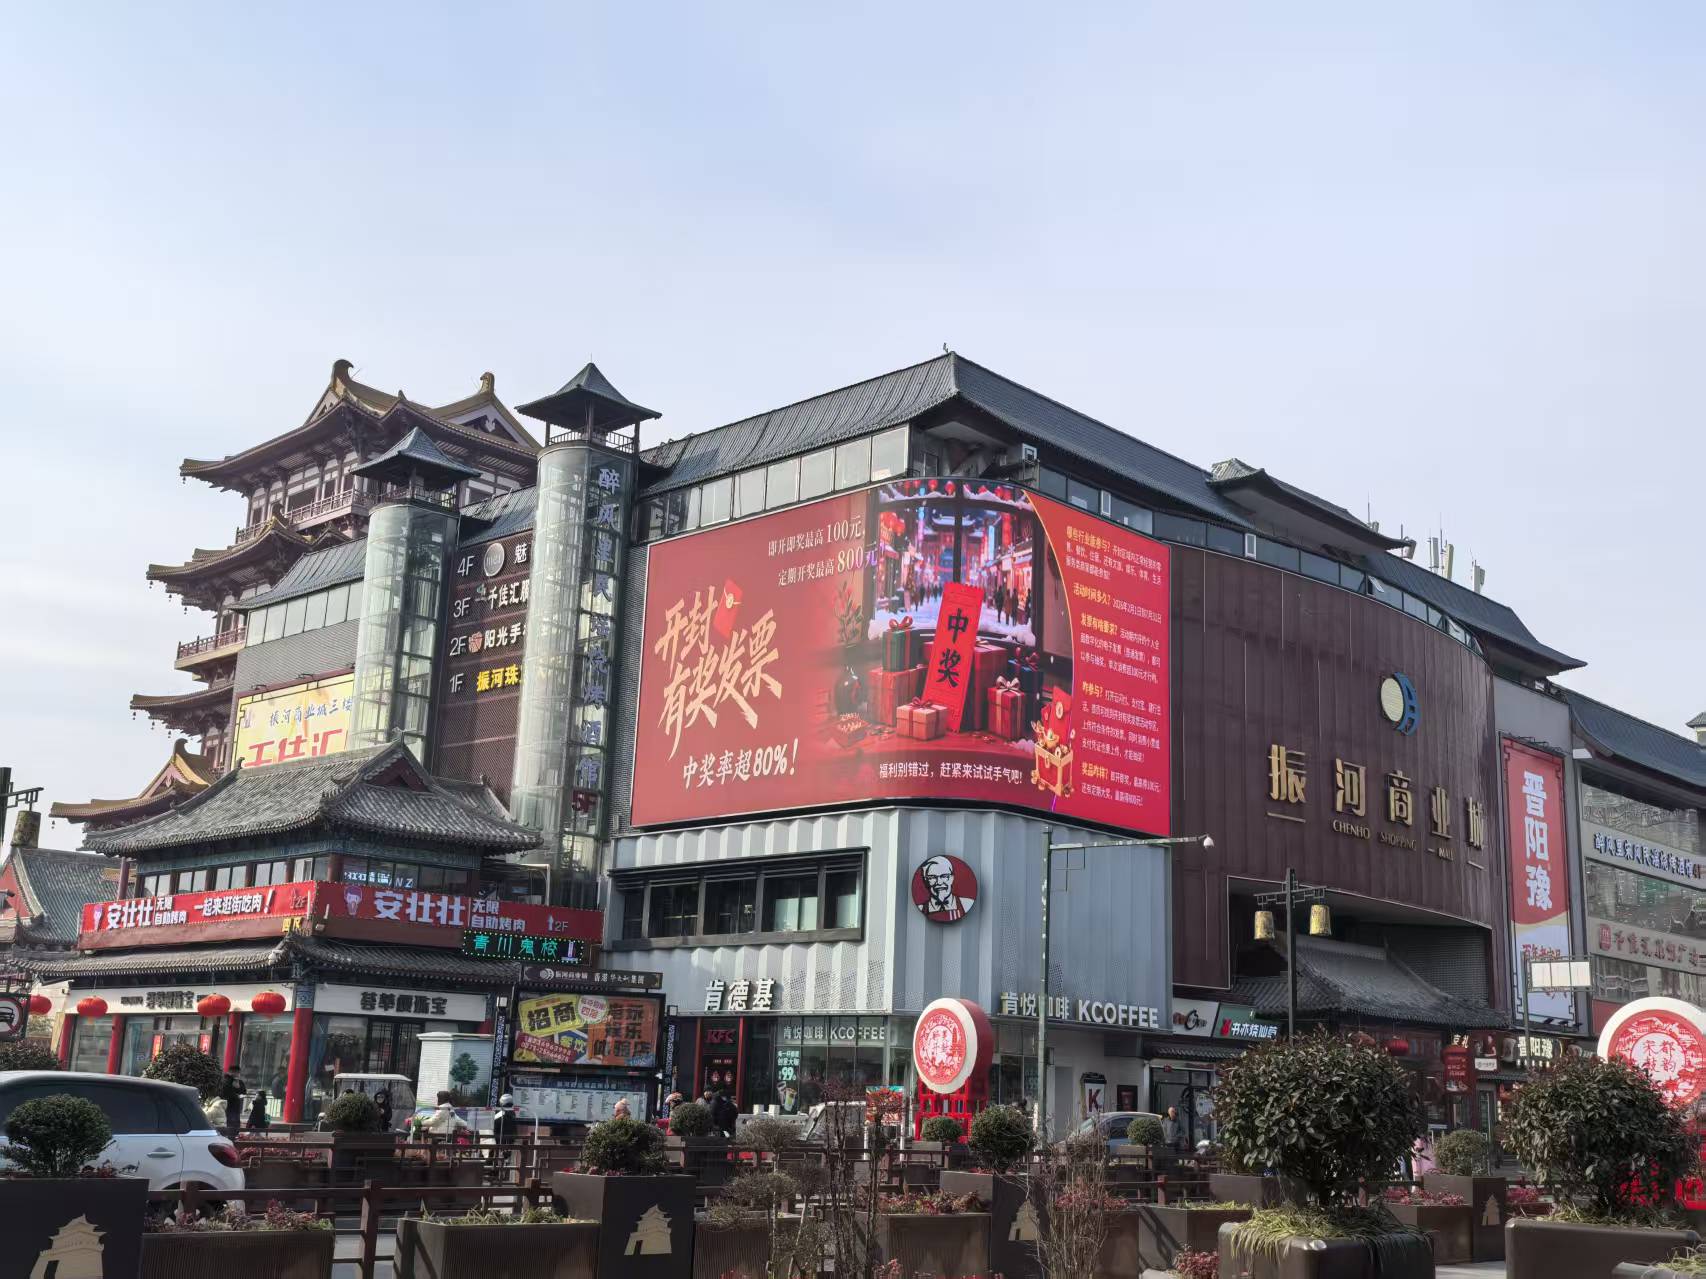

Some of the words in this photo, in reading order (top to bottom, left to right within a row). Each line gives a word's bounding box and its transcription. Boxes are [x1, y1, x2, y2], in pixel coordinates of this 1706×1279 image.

[457, 555, 475, 577] 4F
[453, 597, 471, 618] 3F
[449, 635, 468, 657] 2F
[484, 622, 528, 649] 阳光手
[655, 585, 719, 679] 开封
[936, 608, 969, 688] 中奖
[449, 672, 464, 693] 1F
[477, 664, 524, 692] 振河珠
[657, 608, 783, 761] 有奖发票
[1521, 770, 1553, 911] 晋阳豫
[107, 899, 153, 929] 安壮壮
[156, 896, 173, 911] 无限
[194, 889, 275, 917] 一起来逛街吃肉！
[374, 891, 466, 926] 安壮壮
[472, 899, 500, 915] 无限
[154, 910, 187, 925] 自助烤肉
[471, 915, 527, 932] 自助烤肉
[554, 920, 569, 932] 2F
[704, 977, 776, 1012] 肯德基
[527, 1002, 577, 1031] 招商
[1077, 1001, 1160, 1029] KCOFFEE
[830, 1025, 885, 1041] KCOFFEE
